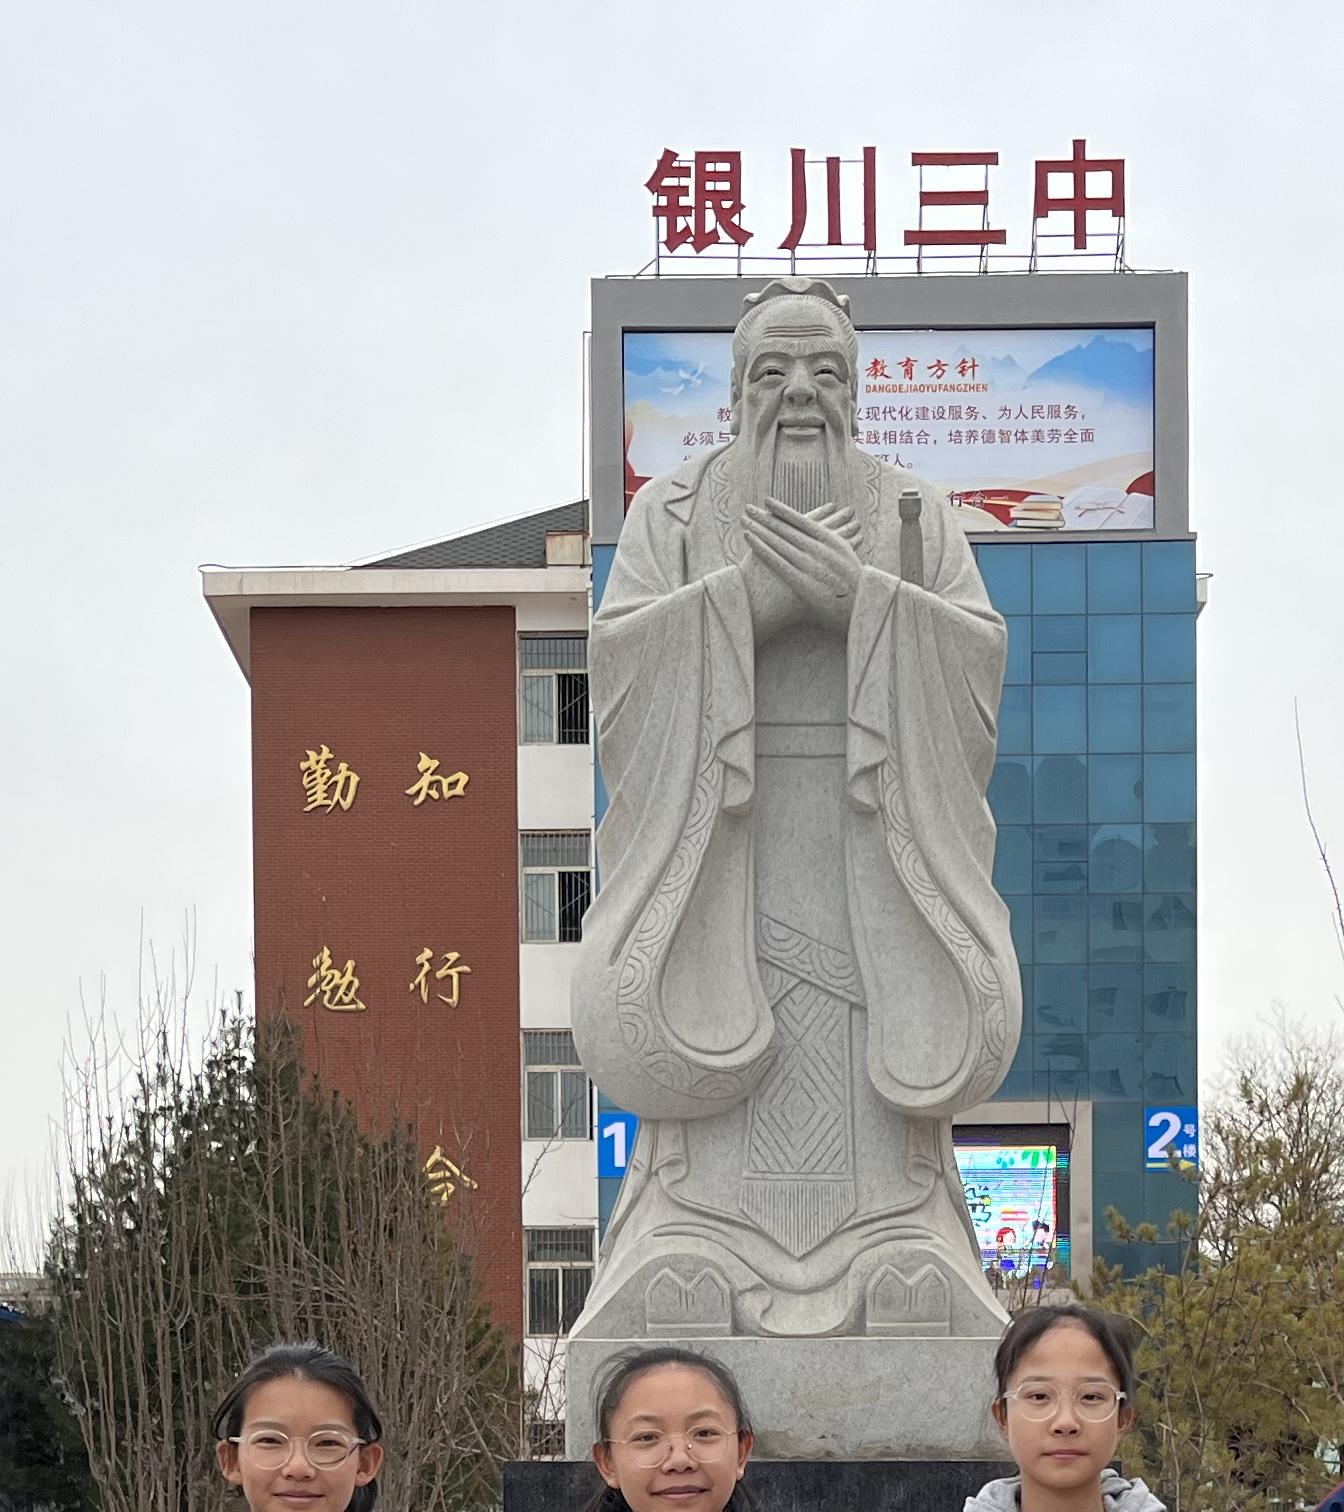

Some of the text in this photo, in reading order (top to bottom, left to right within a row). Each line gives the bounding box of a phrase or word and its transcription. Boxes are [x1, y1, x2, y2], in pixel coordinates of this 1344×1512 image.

[644, 139, 1125, 255] 银川三中
[865, 357, 980, 382] 教育方针
[603, 1121, 626, 1168] 1
